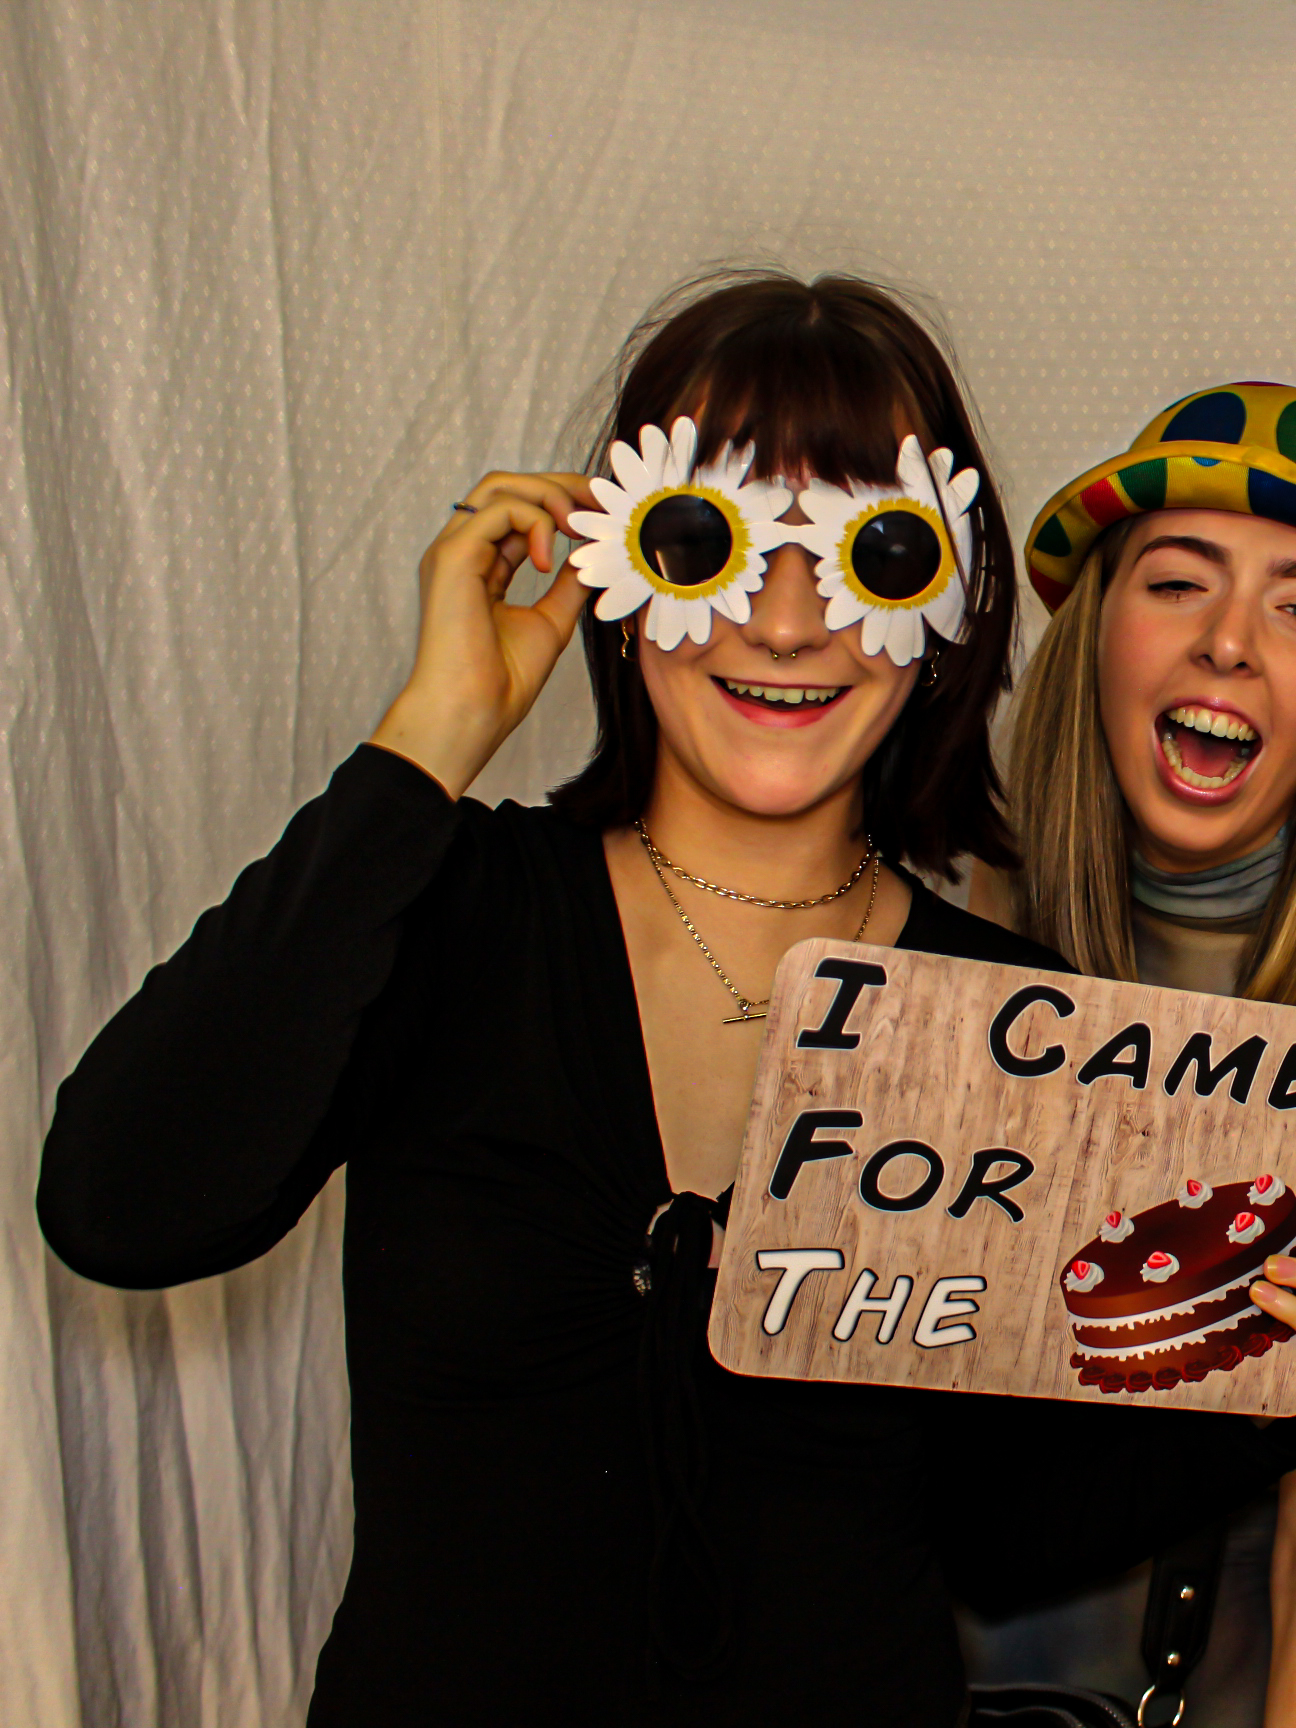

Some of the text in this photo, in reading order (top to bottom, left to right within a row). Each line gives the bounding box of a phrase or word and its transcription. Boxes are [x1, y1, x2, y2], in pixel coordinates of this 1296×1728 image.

[797, 957, 887, 1050] I
[768, 1109, 1035, 1223] FOR
[756, 1248, 987, 1348] THE
